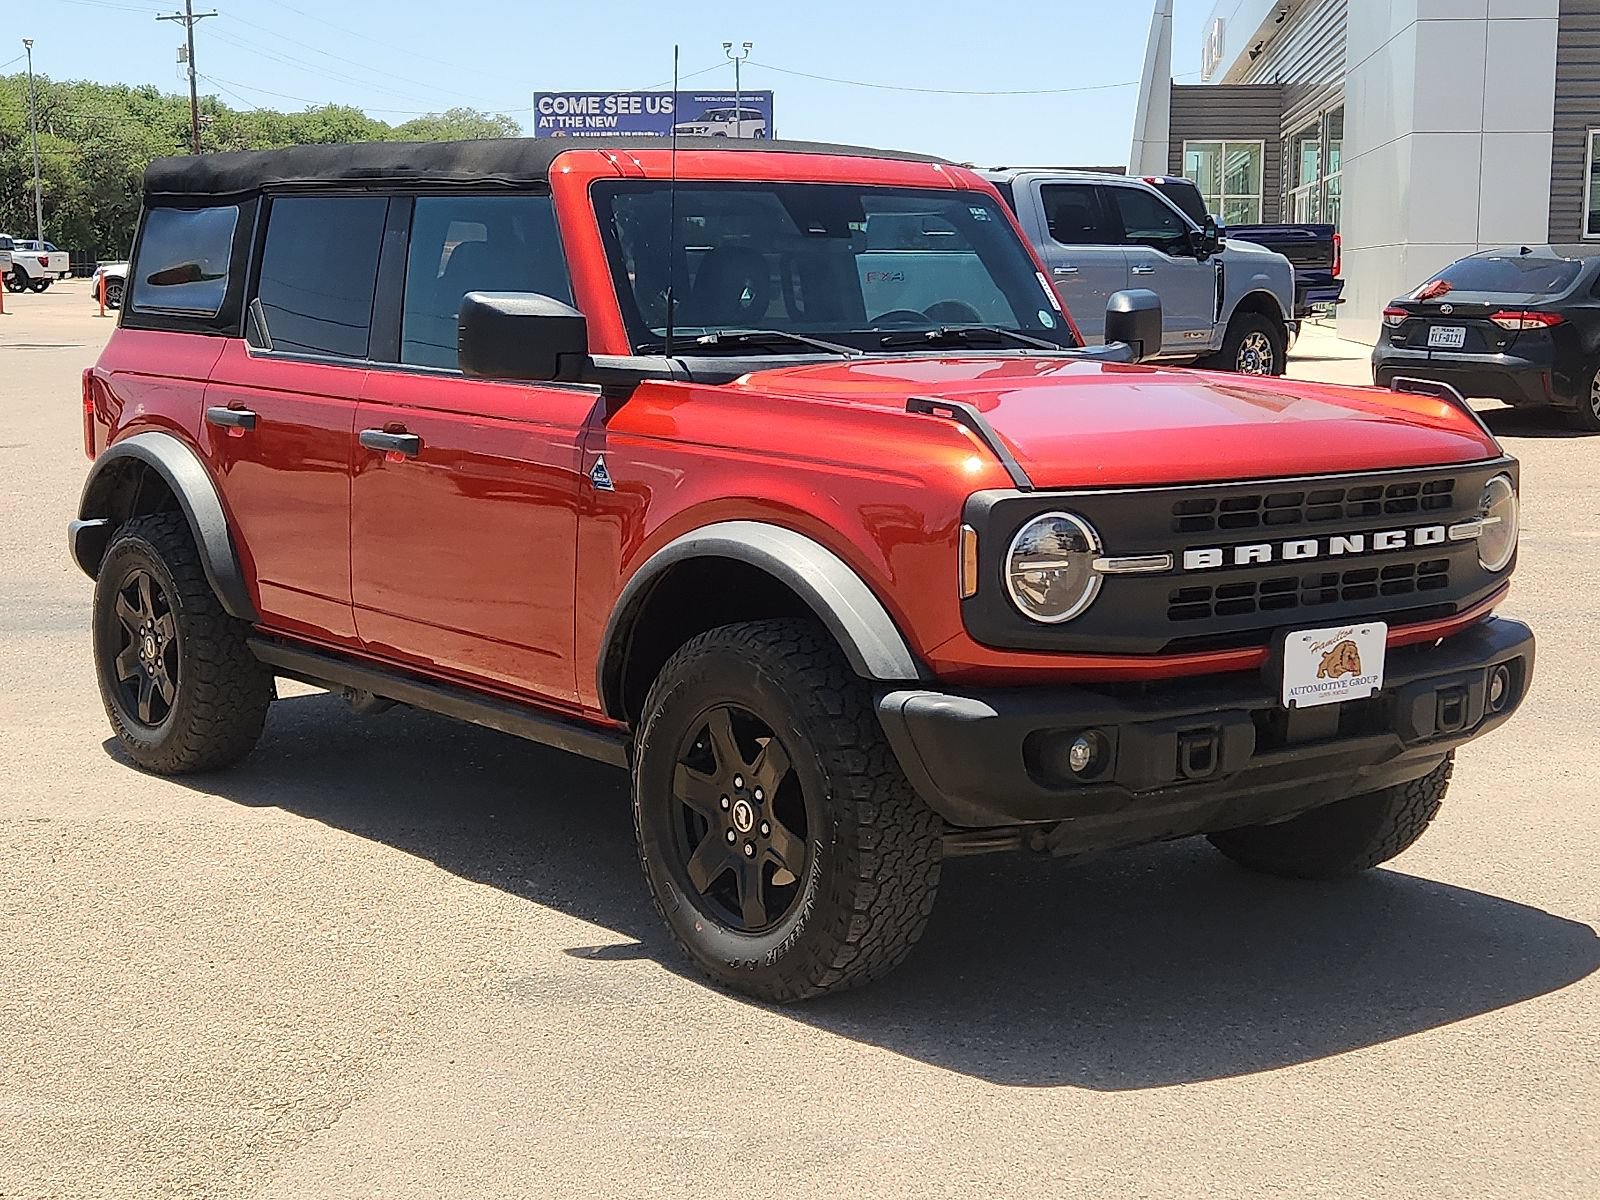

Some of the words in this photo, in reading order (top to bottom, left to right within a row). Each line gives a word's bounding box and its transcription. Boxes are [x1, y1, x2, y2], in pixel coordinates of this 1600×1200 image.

[538, 96, 600, 115] COME
[603, 96, 642, 115] SEE
[645, 96, 674, 115] US
[538, 116, 556, 128] AT
[556, 116, 584, 128] THE
[585, 116, 618, 128] NEW
[866, 271, 905, 282] FX4
[1183, 526, 1446, 569] BRONCO
[1289, 680, 1348, 696] AUTOMOTIVE
[1349, 675, 1378, 687] GROUP
